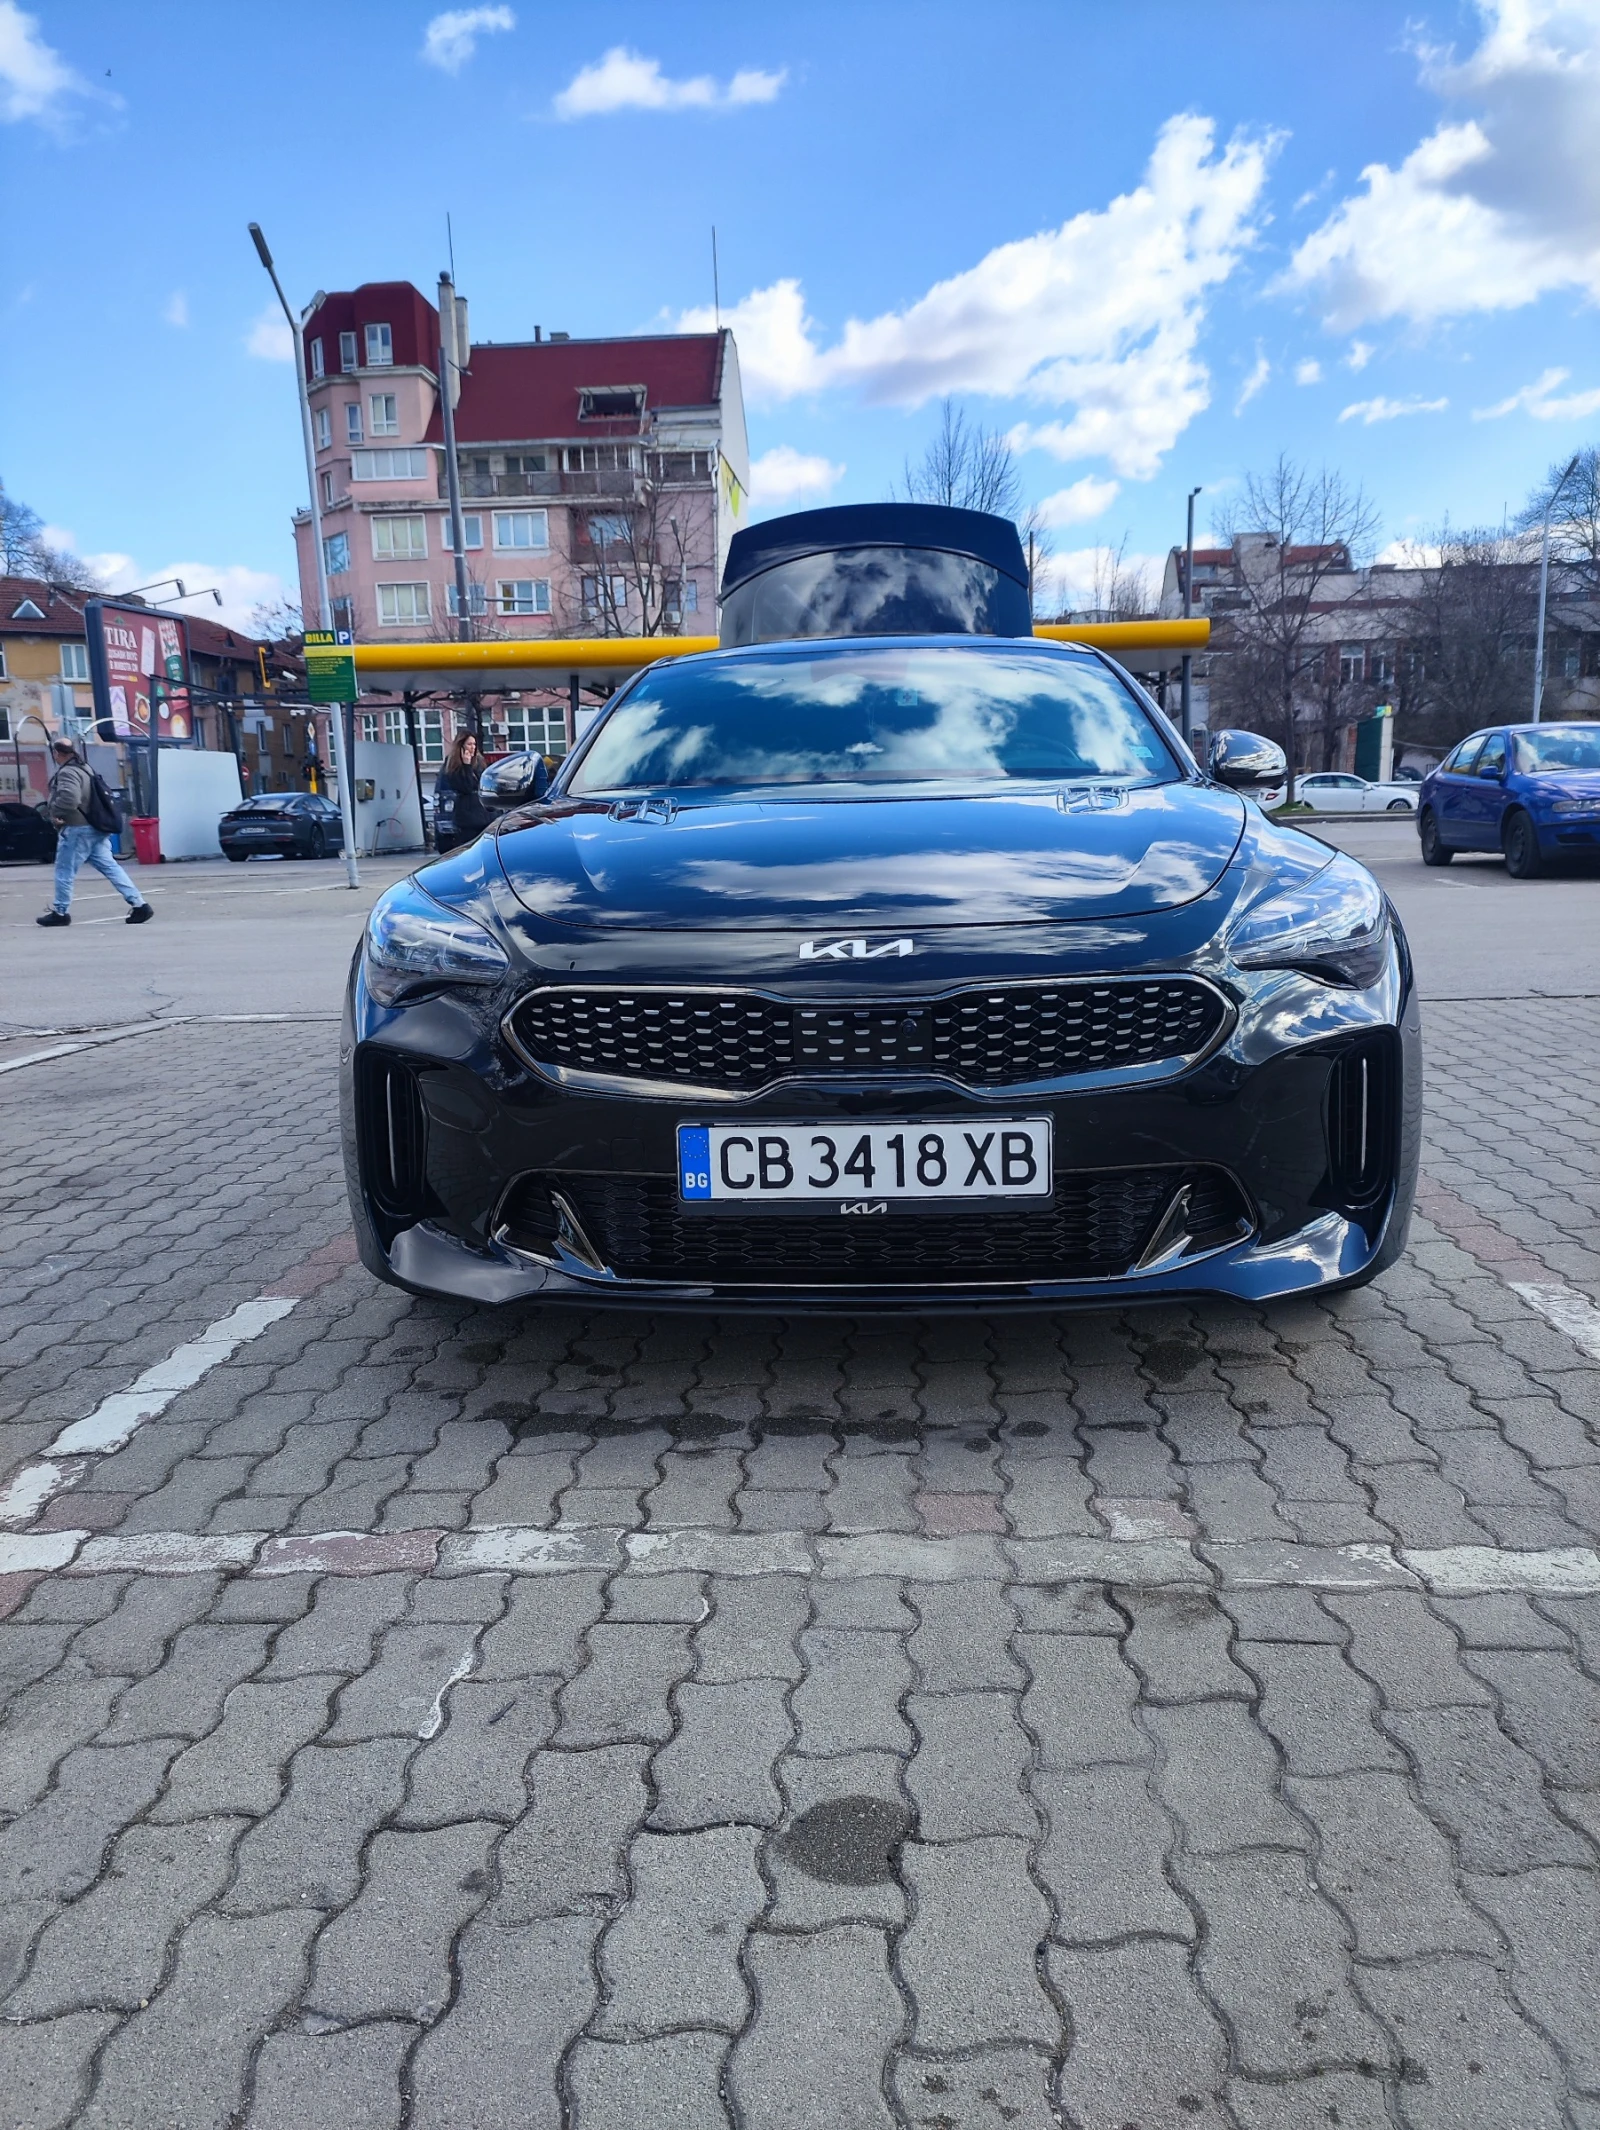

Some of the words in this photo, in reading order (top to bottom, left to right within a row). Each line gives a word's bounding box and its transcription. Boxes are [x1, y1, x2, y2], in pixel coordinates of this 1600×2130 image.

[103, 626, 138, 650] TIRA
[305, 633, 334, 643] BILLA
[338, 631, 349, 644] P
[799, 939, 914, 958] KIA
[720, 1136, 794, 1189] CB
[808, 1133, 947, 1188] 3418
[963, 1132, 1037, 1187] XB
[685, 1173, 708, 1188] BG
[841, 1202, 887, 1214] KIA
